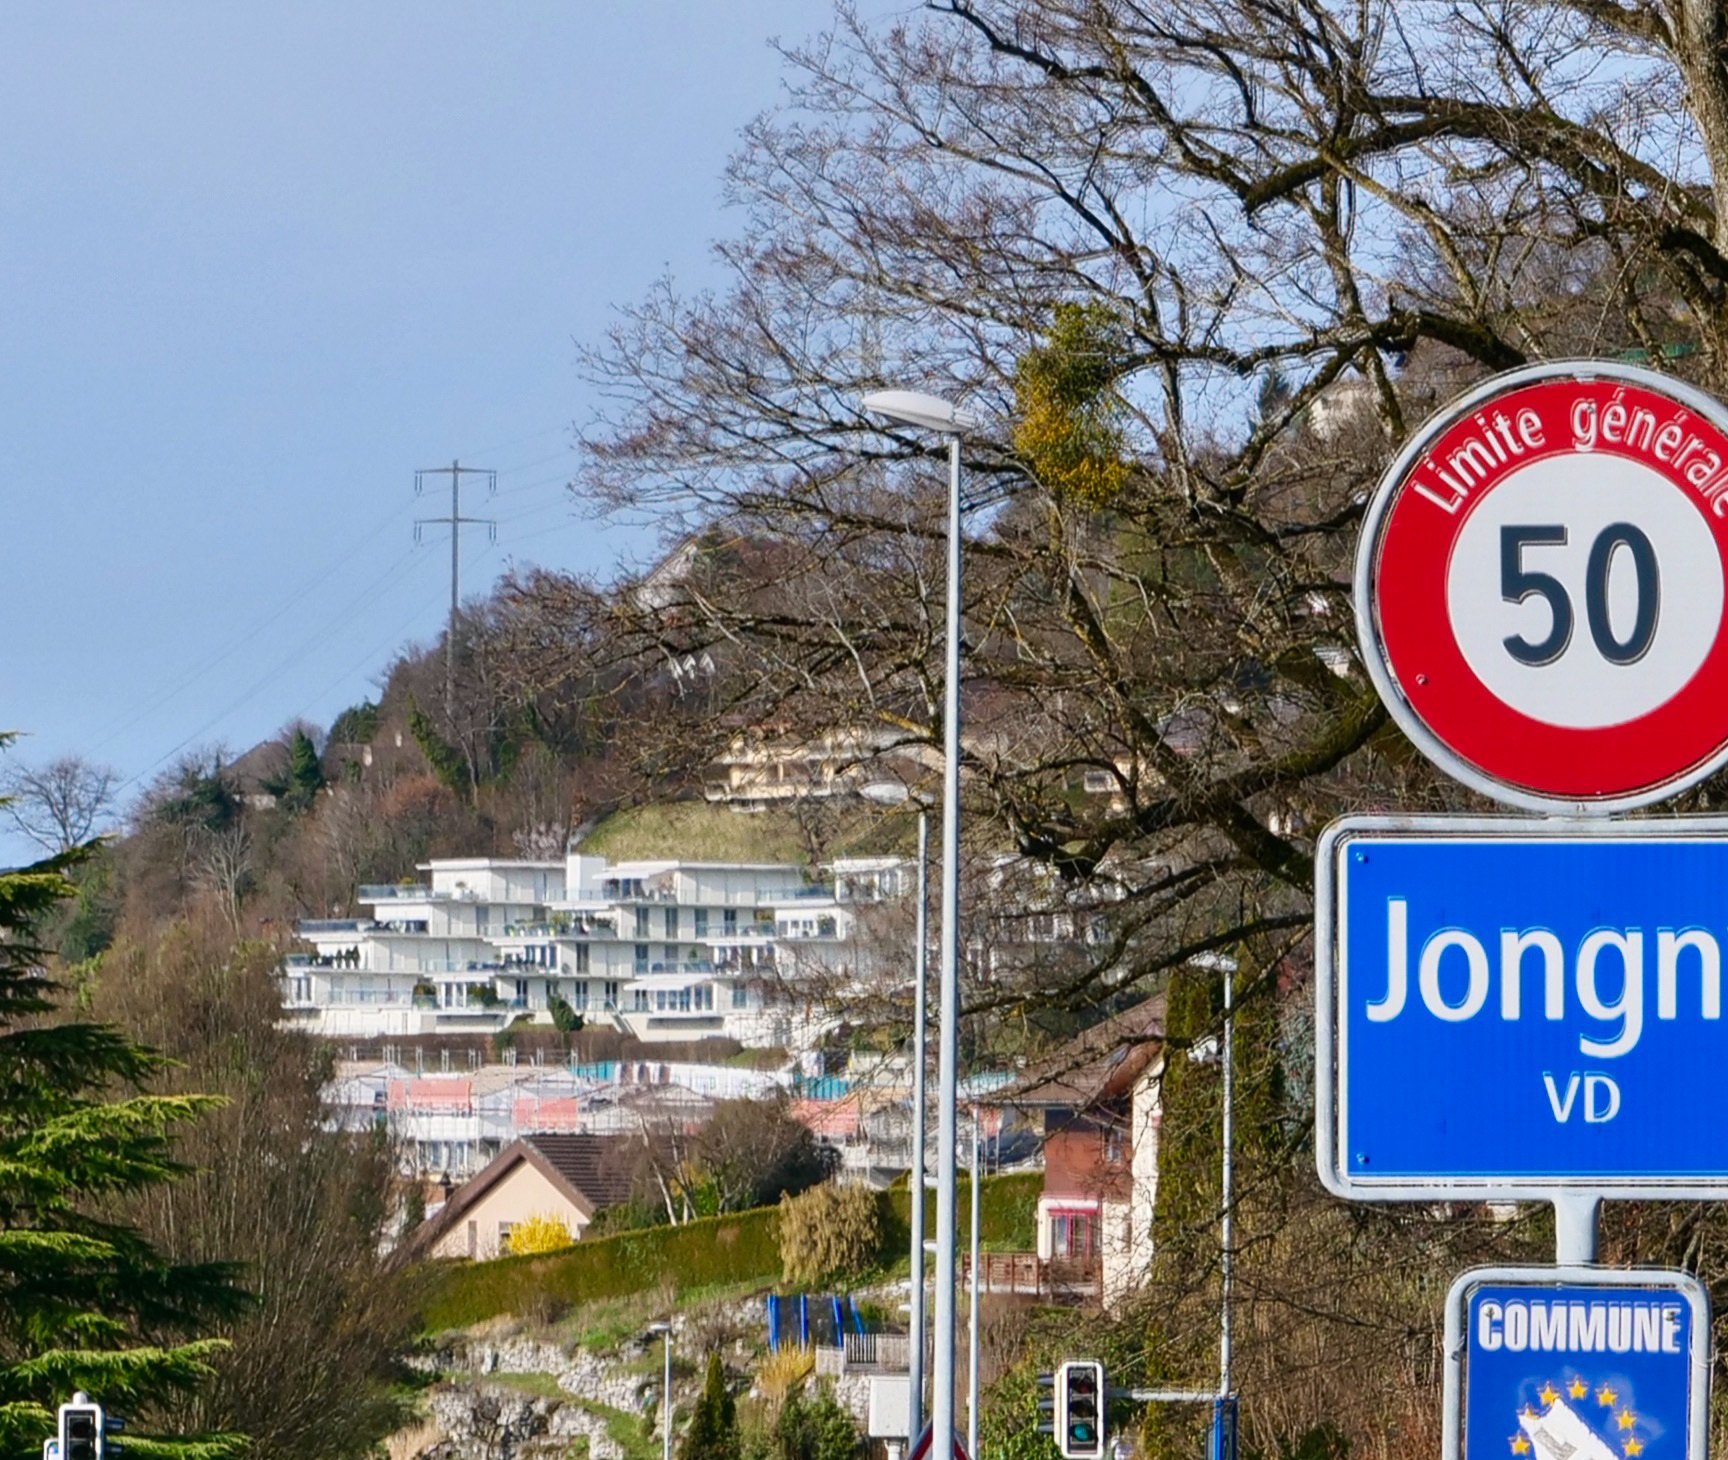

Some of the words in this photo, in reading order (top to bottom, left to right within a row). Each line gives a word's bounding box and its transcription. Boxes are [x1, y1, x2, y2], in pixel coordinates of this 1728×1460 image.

[1411, 408, 1546, 515] Limite
[1500, 522, 1662, 667] 50
[1543, 1072, 1621, 1123] VD
[1477, 1301, 1682, 1353] COMMUNE
